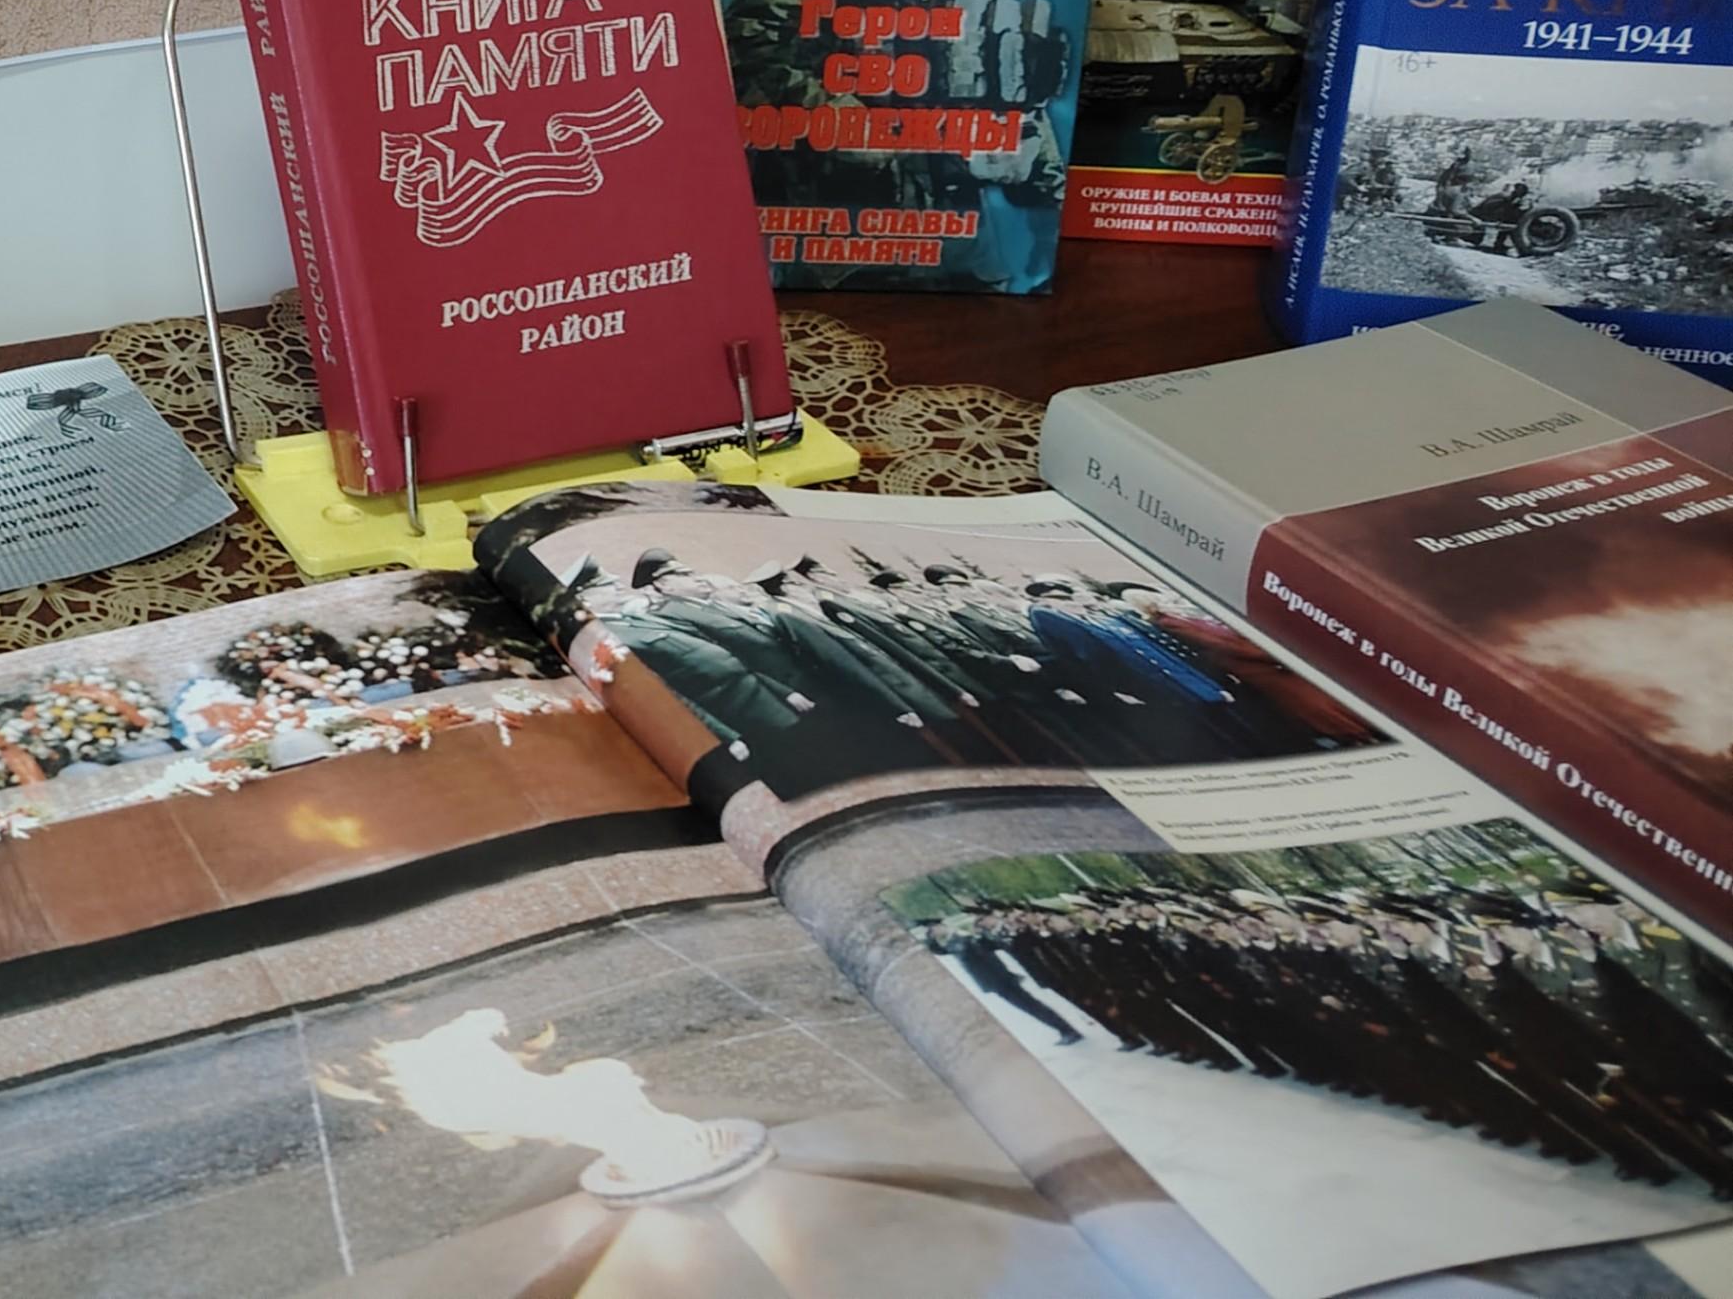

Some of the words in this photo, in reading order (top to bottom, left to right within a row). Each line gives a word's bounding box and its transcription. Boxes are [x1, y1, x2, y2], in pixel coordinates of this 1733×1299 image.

[376, 12, 679, 111] ПАМЯТИ
[823, 54, 931, 97] СВО
[1081, 187, 1150, 200] ОРУЖИЕ
[1169, 190, 1231, 203] БОЕВАЯ
[1090, 201, 1202, 217] КРУПНЕЙШИЕ
[265, 92, 338, 366] РОССОШАНСКИЙ
[858, 207, 978, 238] СЛАВЫ
[1094, 218, 1153, 230] ВОИНЫ
[772, 240, 793, 263] И
[803, 237, 941, 266] ПАМЯТИ
[441, 252, 693, 328] РОССОШАНСКИЙ
[519, 310, 626, 354] РАЙОН
[1420, 434, 1477, 459] В.А.
[1484, 411, 1584, 445] Шамрай
[1085, 457, 1131, 498] В.А.
[1136, 490, 1226, 563] Шамрай
[1263, 569, 1358, 644] Воронеж
[1360, 640, 1376, 658] в
[1380, 645, 1438, 699] годы
[1443, 687, 1551, 771] Великой
